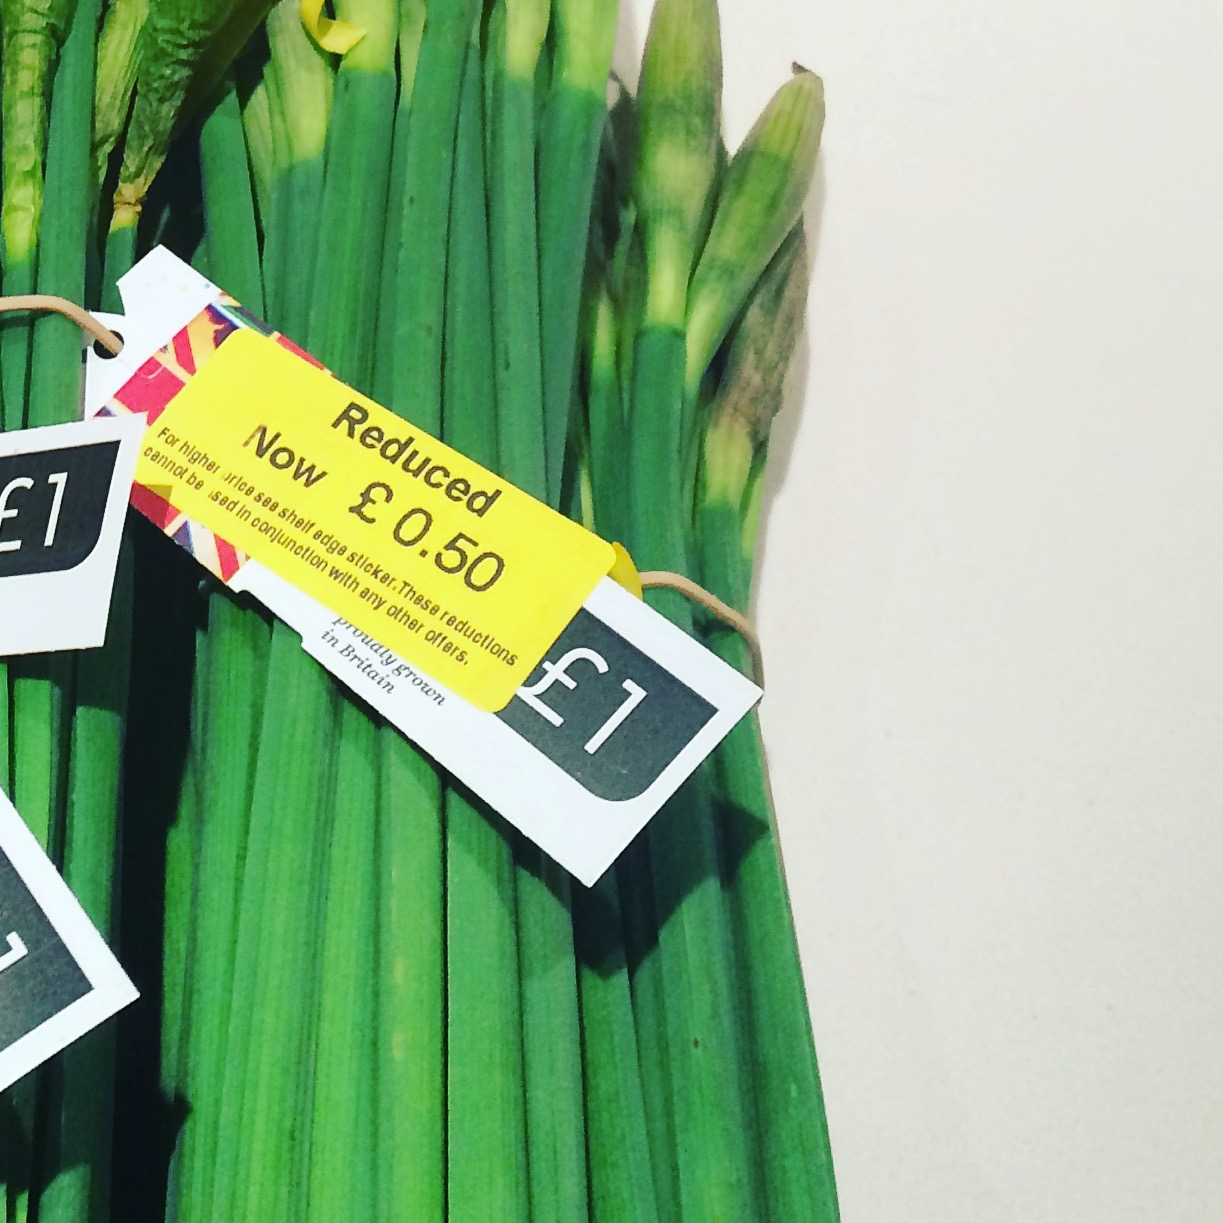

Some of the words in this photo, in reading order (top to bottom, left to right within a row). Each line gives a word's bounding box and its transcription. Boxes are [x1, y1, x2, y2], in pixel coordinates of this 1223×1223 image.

[242, 424, 328, 488] Now
[348, 481, 394, 524] £
[393, 507, 505, 593] 0.50
[330, 401, 503, 518] Reduced
[143, 446, 188, 480] cannot
[186, 472, 205, 491] be
[236, 504, 253, 522] in
[251, 515, 328, 572] conjunction
[328, 566, 360, 593] with
[359, 587, 387, 611] any
[386, 604, 426, 634] other
[424, 629, 469, 666] offers.
[157, 426, 180, 448] For
[178, 440, 221, 474] higher
[254, 491, 280, 512] see
[278, 508, 316, 534] shelf
[313, 529, 347, 556] edge
[439, 610, 519, 667] reductions
[321, 628, 339, 648] in
[338, 644, 396, 694] Britain
[391, 663, 446, 706] grown
[515, 647, 648, 755] £1
